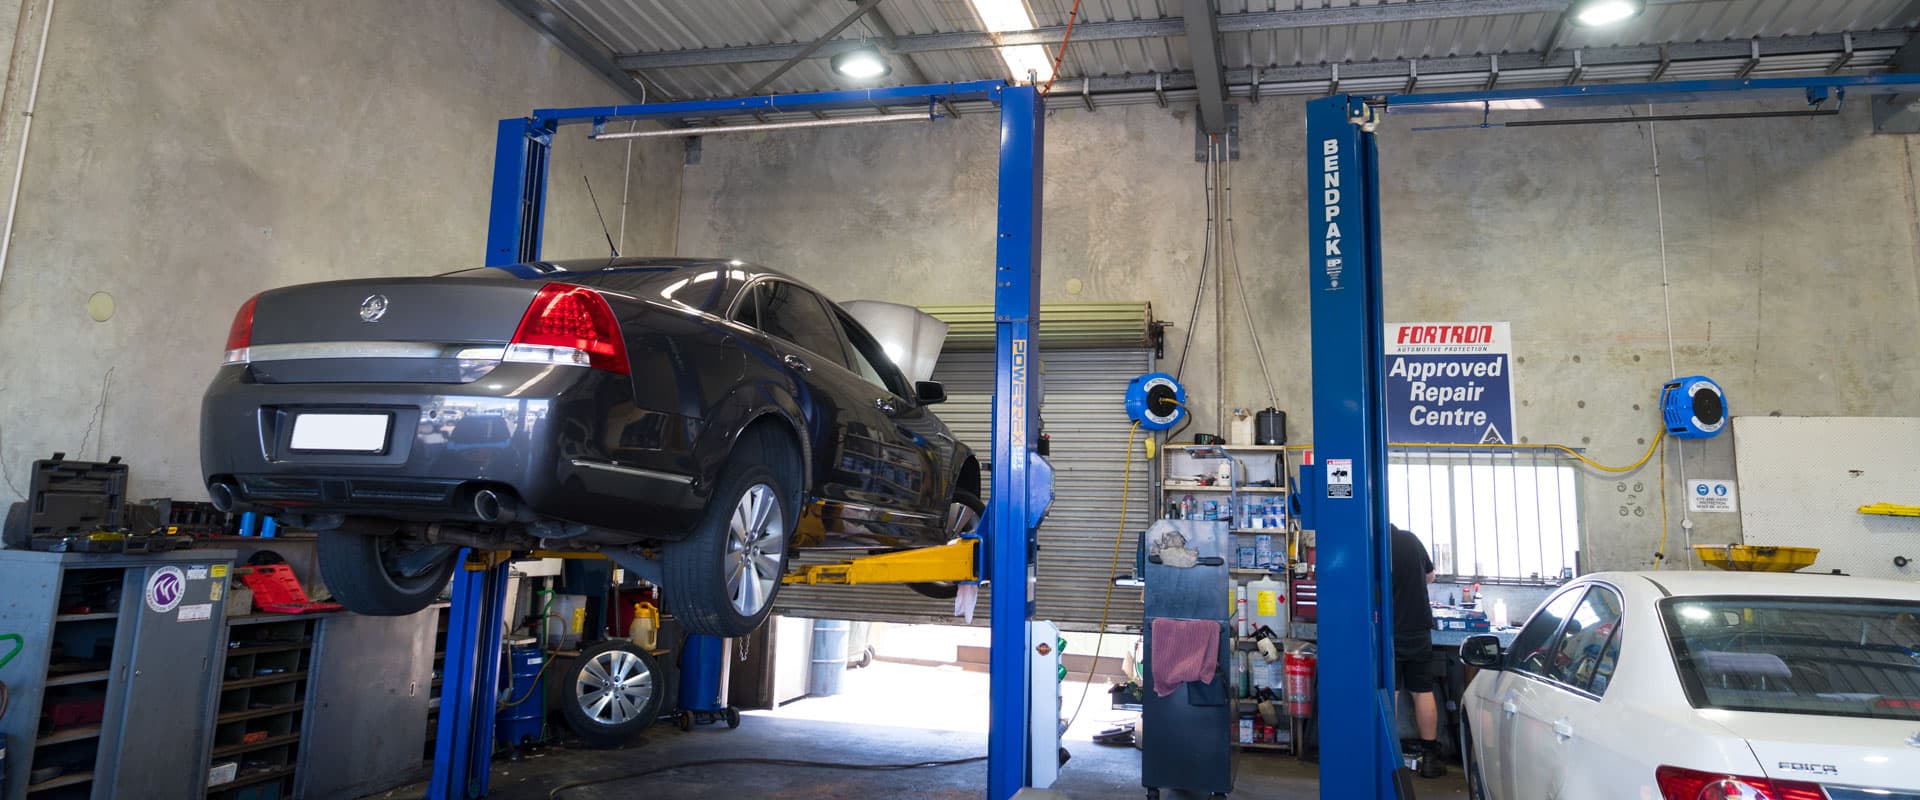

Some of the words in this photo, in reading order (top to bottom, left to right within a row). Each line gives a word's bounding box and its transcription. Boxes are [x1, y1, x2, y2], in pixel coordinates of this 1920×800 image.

[1323, 138, 1342, 257] BENDPAK
[1397, 325, 1493, 345] FORTRON
[1389, 357, 1502, 382] Approved
[1409, 381, 1484, 406] Repair
[1409, 405, 1487, 426] Centre
